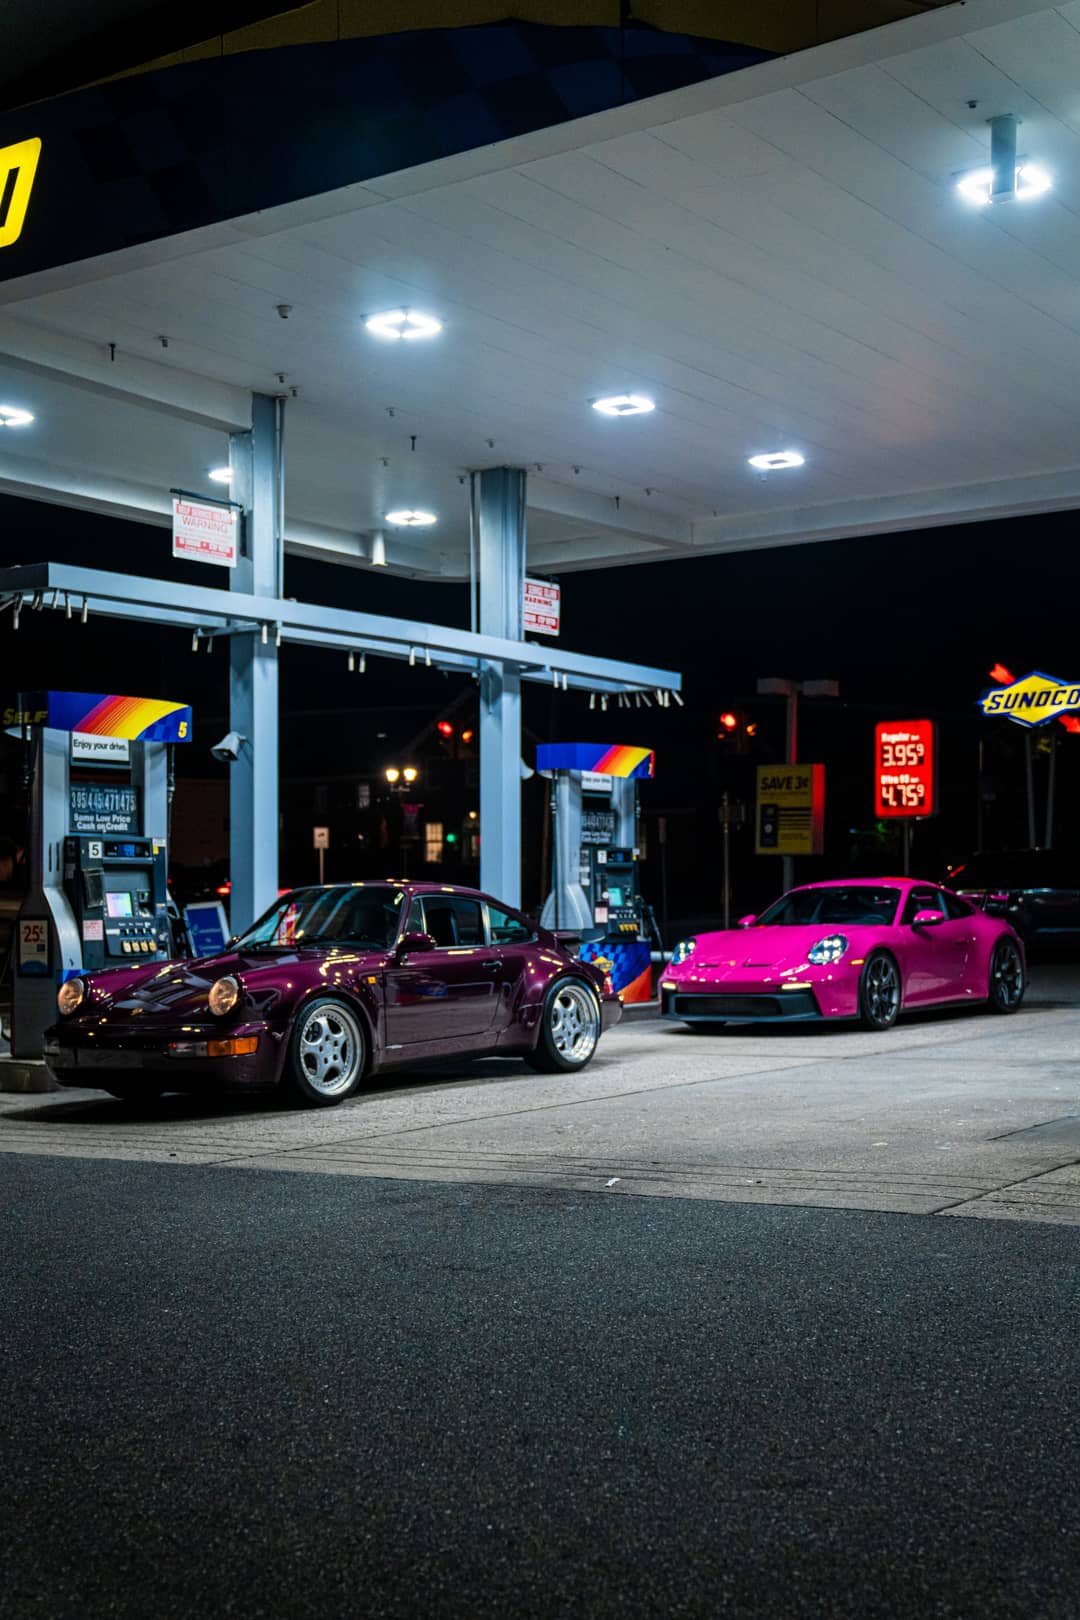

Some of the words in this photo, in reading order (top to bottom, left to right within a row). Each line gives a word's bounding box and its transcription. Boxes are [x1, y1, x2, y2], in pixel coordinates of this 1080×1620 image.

[182, 515, 229, 533] WARNING
[987, 689, 1080, 711] SUNOCO
[178, 721, 188, 739] 5
[73, 739, 92, 750] Enjoy
[93, 742, 107, 750] your
[761, 775, 793, 790] SAVE
[112, 814, 131, 823] Price
[91, 844, 100, 856] 5
